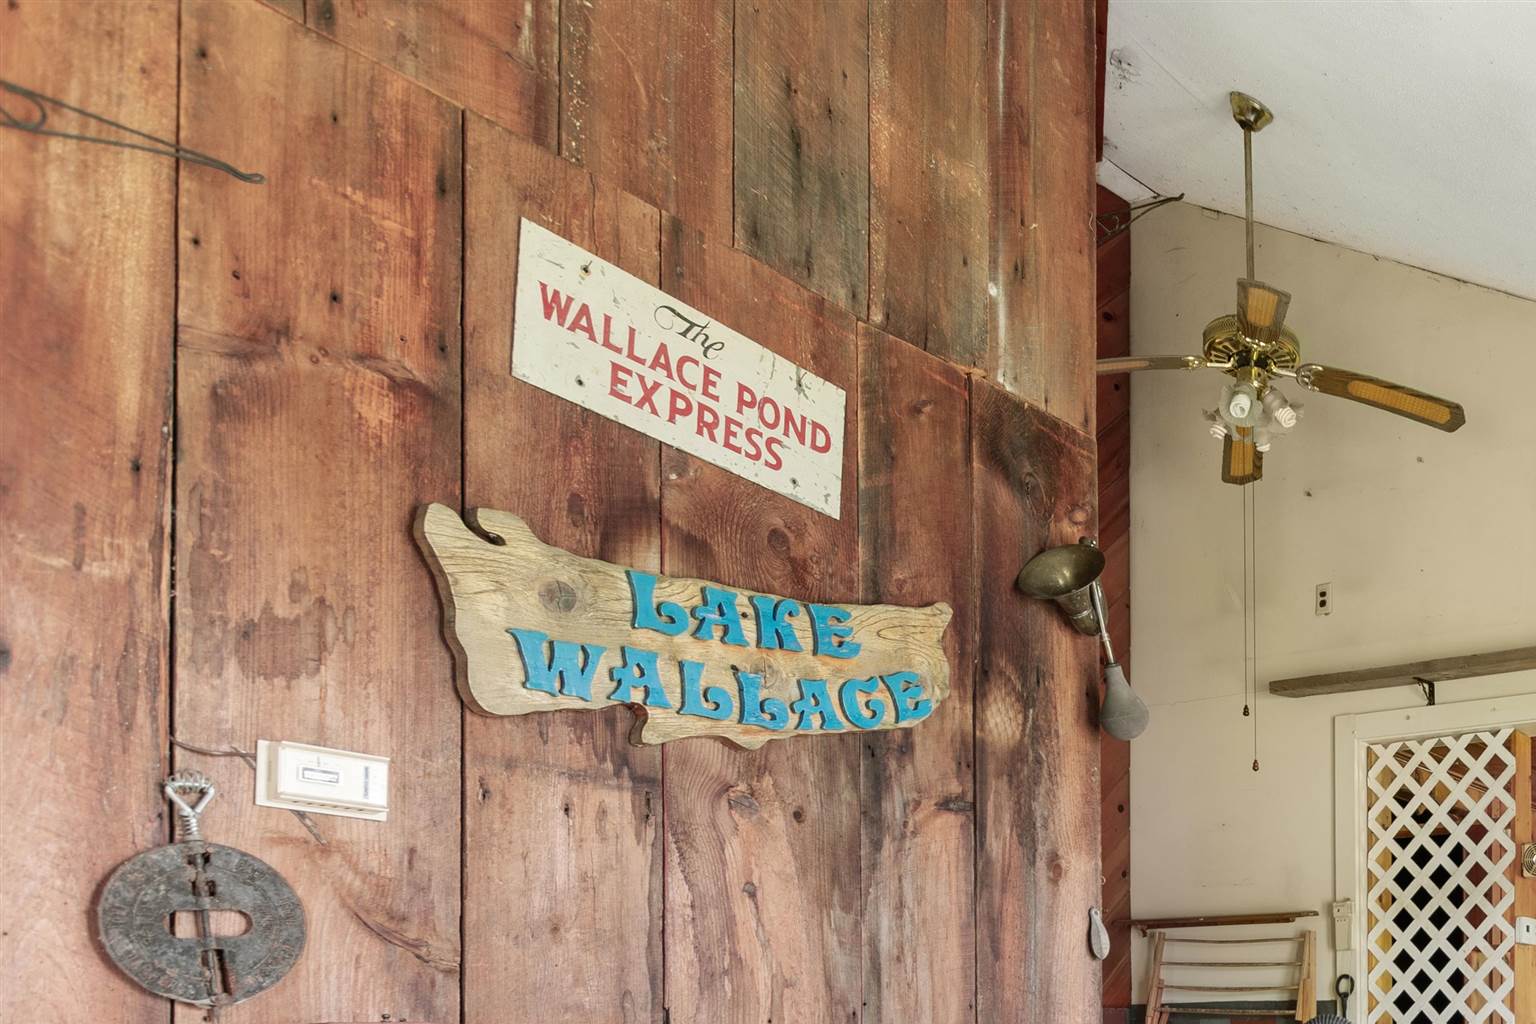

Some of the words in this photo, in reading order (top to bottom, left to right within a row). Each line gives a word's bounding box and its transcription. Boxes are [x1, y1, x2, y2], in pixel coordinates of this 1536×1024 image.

[537, 280, 722, 403] WALLACE
[736, 381, 832, 455] POND
[654, 304, 725, 360] The
[608, 359, 784, 472] EXPRESS
[626, 570, 862, 659] LAKE
[506, 628, 933, 730] WALLACE
